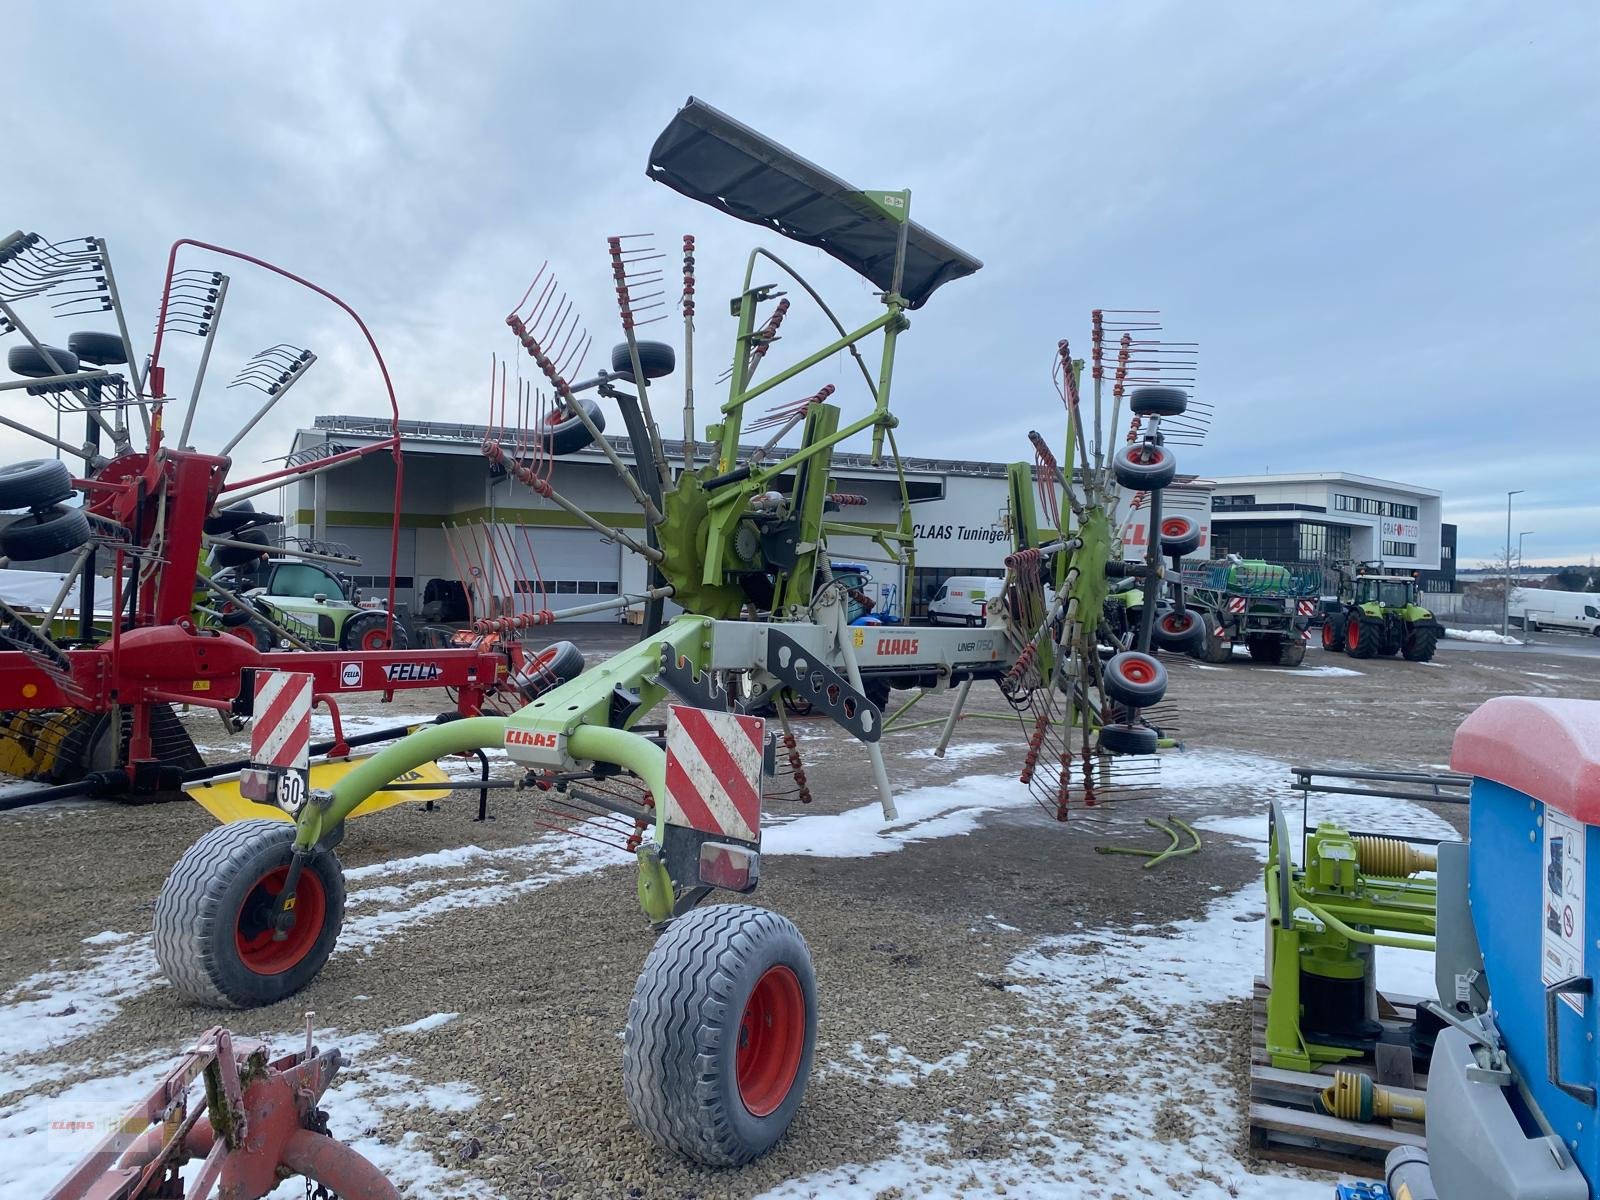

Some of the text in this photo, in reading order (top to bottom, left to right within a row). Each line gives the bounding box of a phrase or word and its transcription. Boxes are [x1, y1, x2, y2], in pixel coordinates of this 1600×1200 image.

[913, 524, 1010, 544] CLAAS Tuningen
[877, 639, 919, 656] CLAAS
[957, 642, 976, 652] LINER
[388, 663, 438, 681] FELLA
[505, 730, 557, 748] CLAAS
[282, 775, 300, 804] 50
